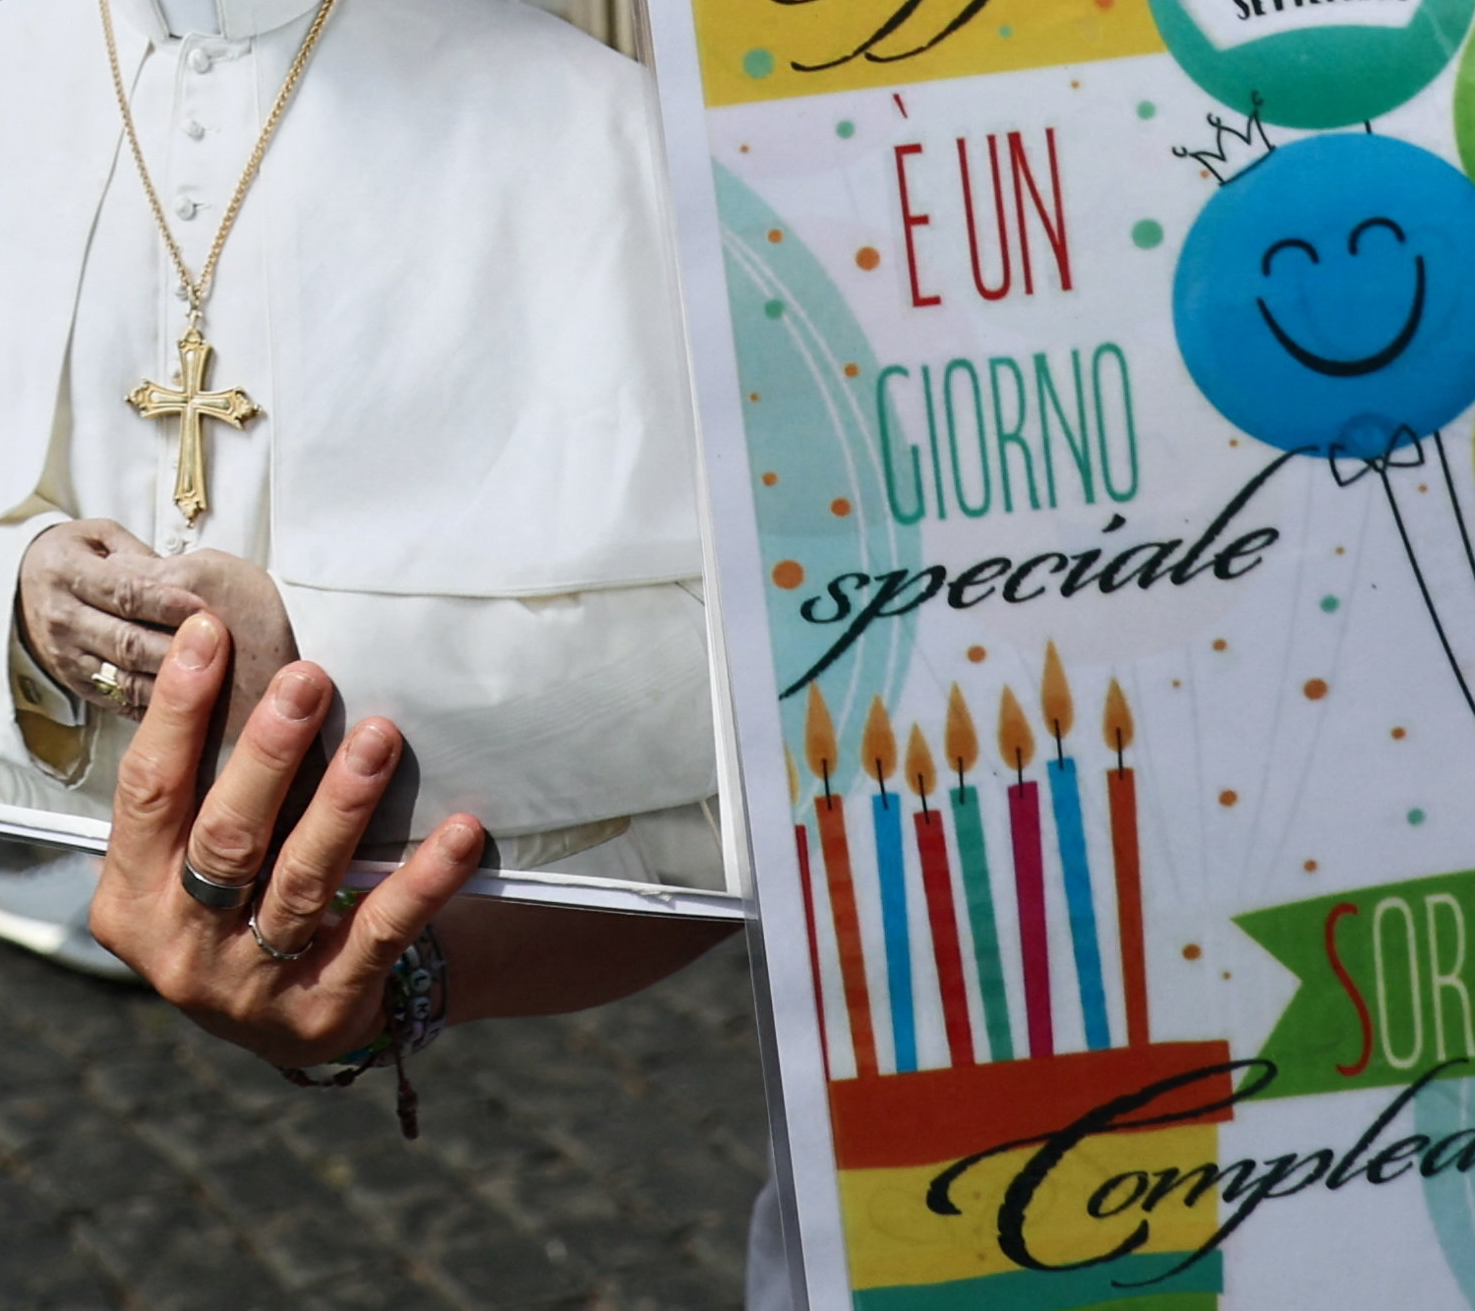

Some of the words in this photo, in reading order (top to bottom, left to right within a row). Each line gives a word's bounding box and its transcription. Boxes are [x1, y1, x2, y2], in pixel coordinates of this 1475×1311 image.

[892, 92, 942, 308] È
[956, 126, 1074, 302] UN
[875, 341, 1141, 527] GIORNO
[778, 444, 1320, 701] speciale
